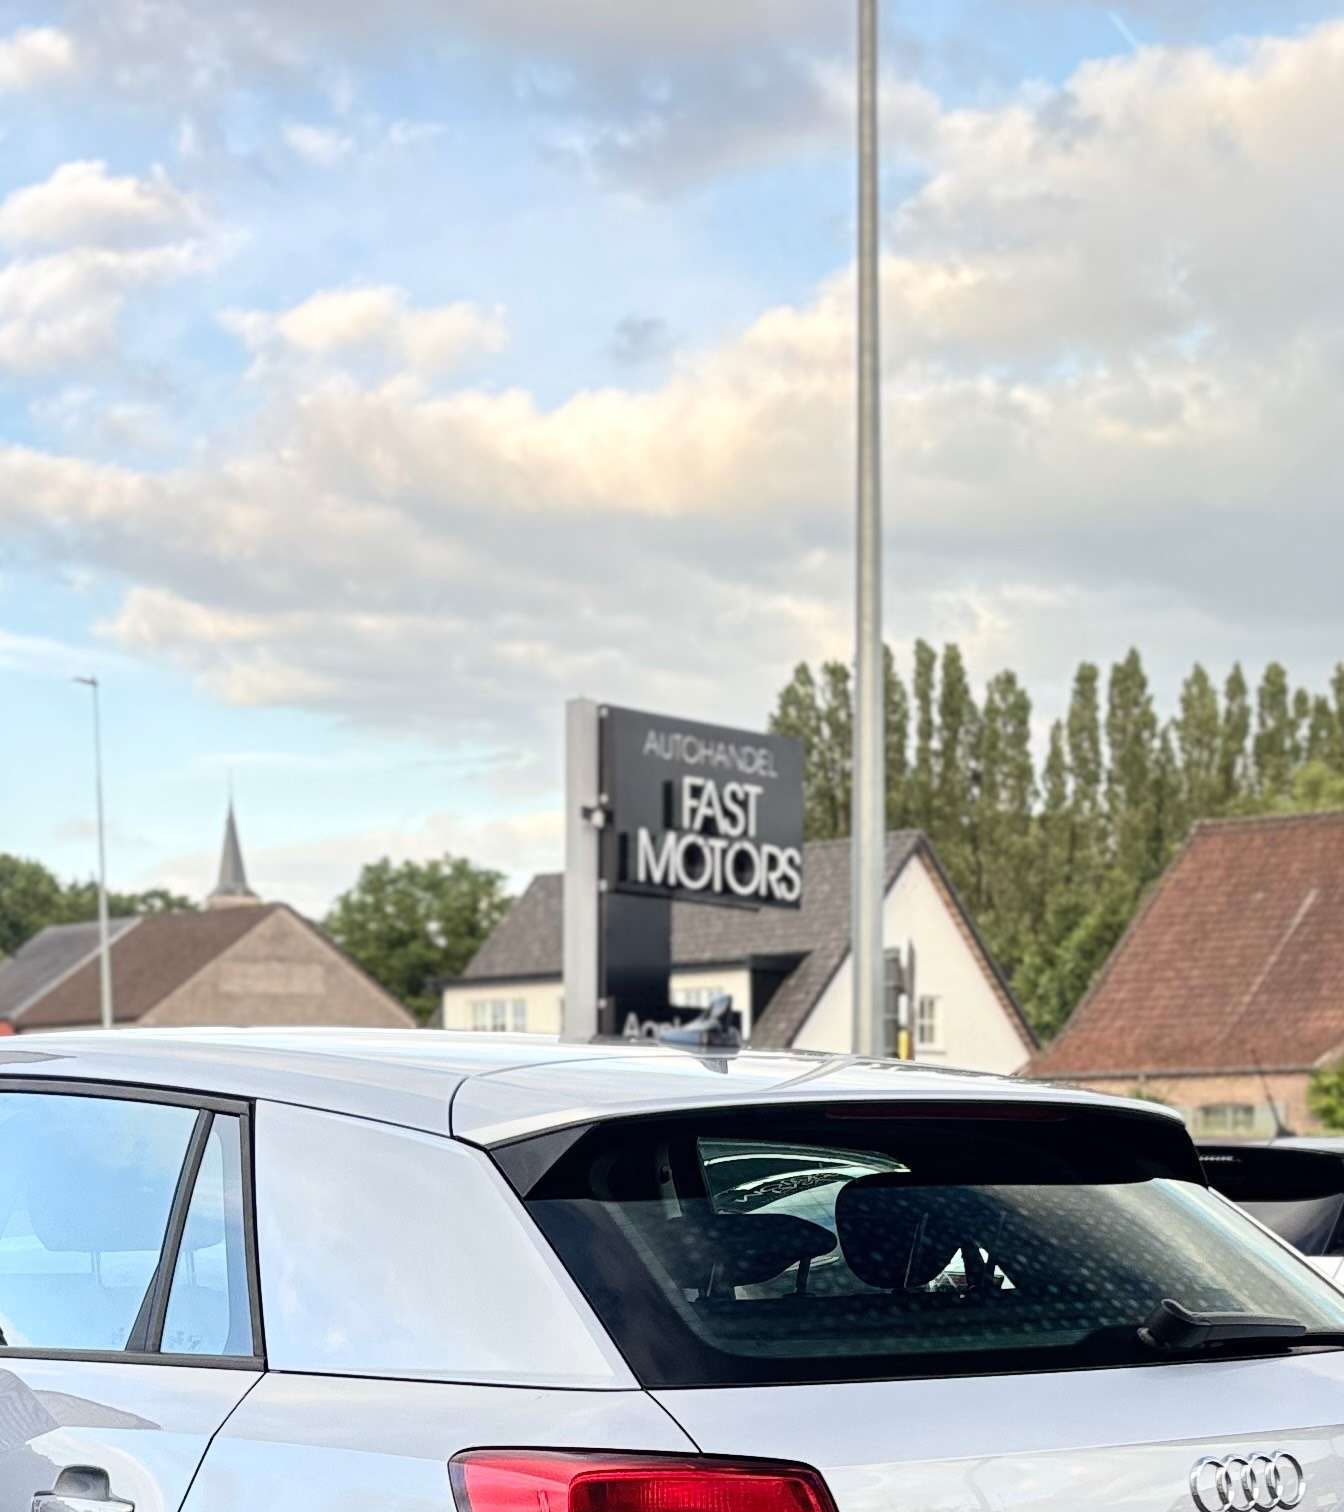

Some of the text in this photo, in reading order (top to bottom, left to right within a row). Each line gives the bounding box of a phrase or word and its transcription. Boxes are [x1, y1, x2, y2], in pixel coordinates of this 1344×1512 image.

[643, 729, 778, 778] AUTOHANDEL
[682, 775, 764, 837] FAST
[637, 826, 801, 901] MOTORS
